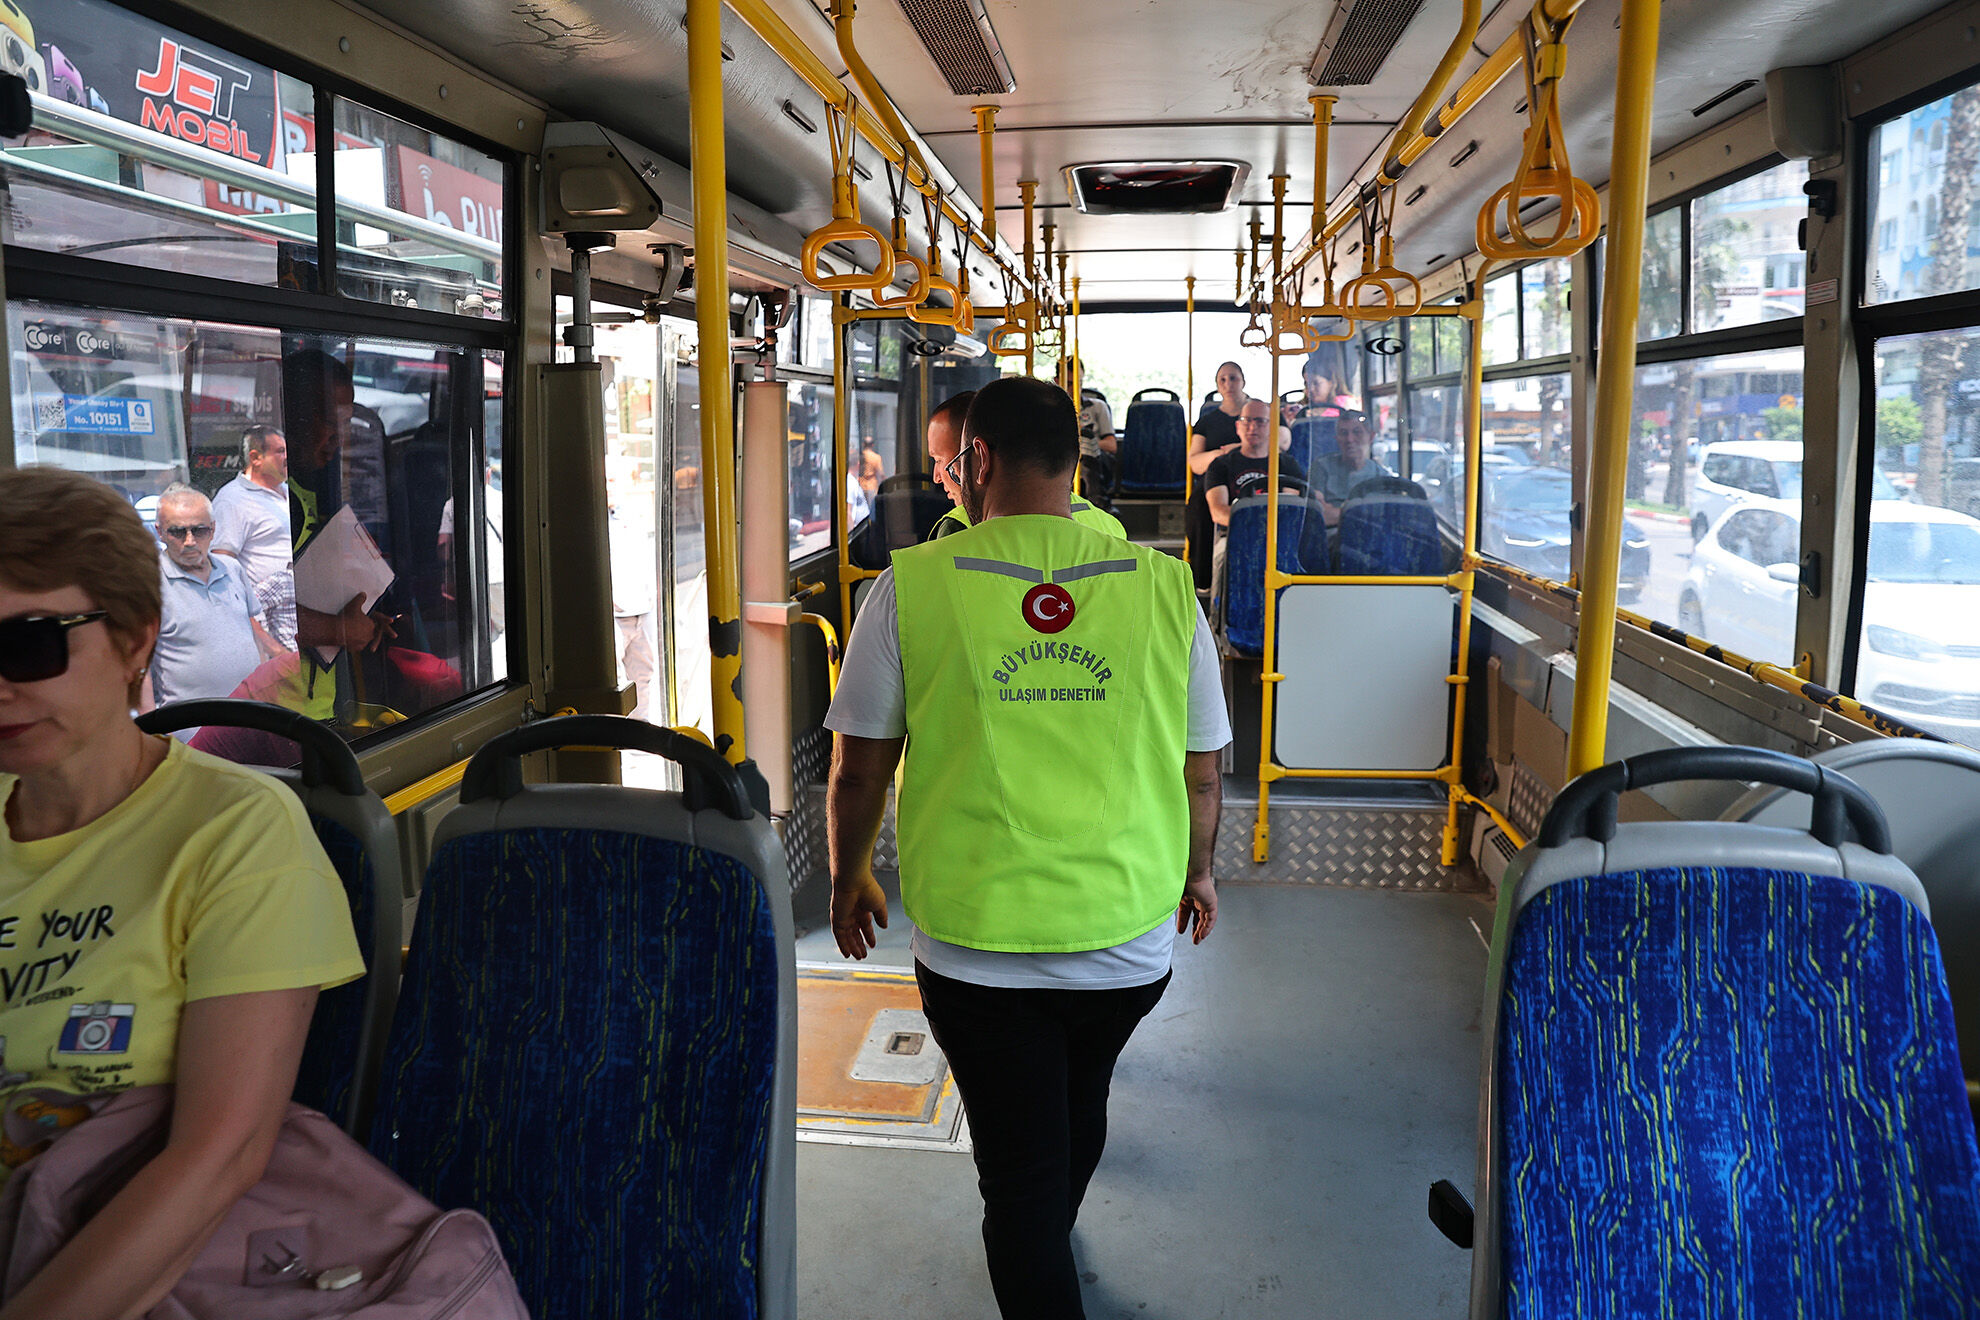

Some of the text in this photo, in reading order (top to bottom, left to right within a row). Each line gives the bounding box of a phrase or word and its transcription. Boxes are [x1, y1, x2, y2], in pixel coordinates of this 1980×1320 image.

[136, 37, 252, 121] JET
[89, 411, 122, 426] 10151
[992, 640, 1113, 685] BÜYÜKŞEHİR
[999, 686, 1106, 704] ULAŞIM DENETİM
[37, 904, 115, 948] YOUR
